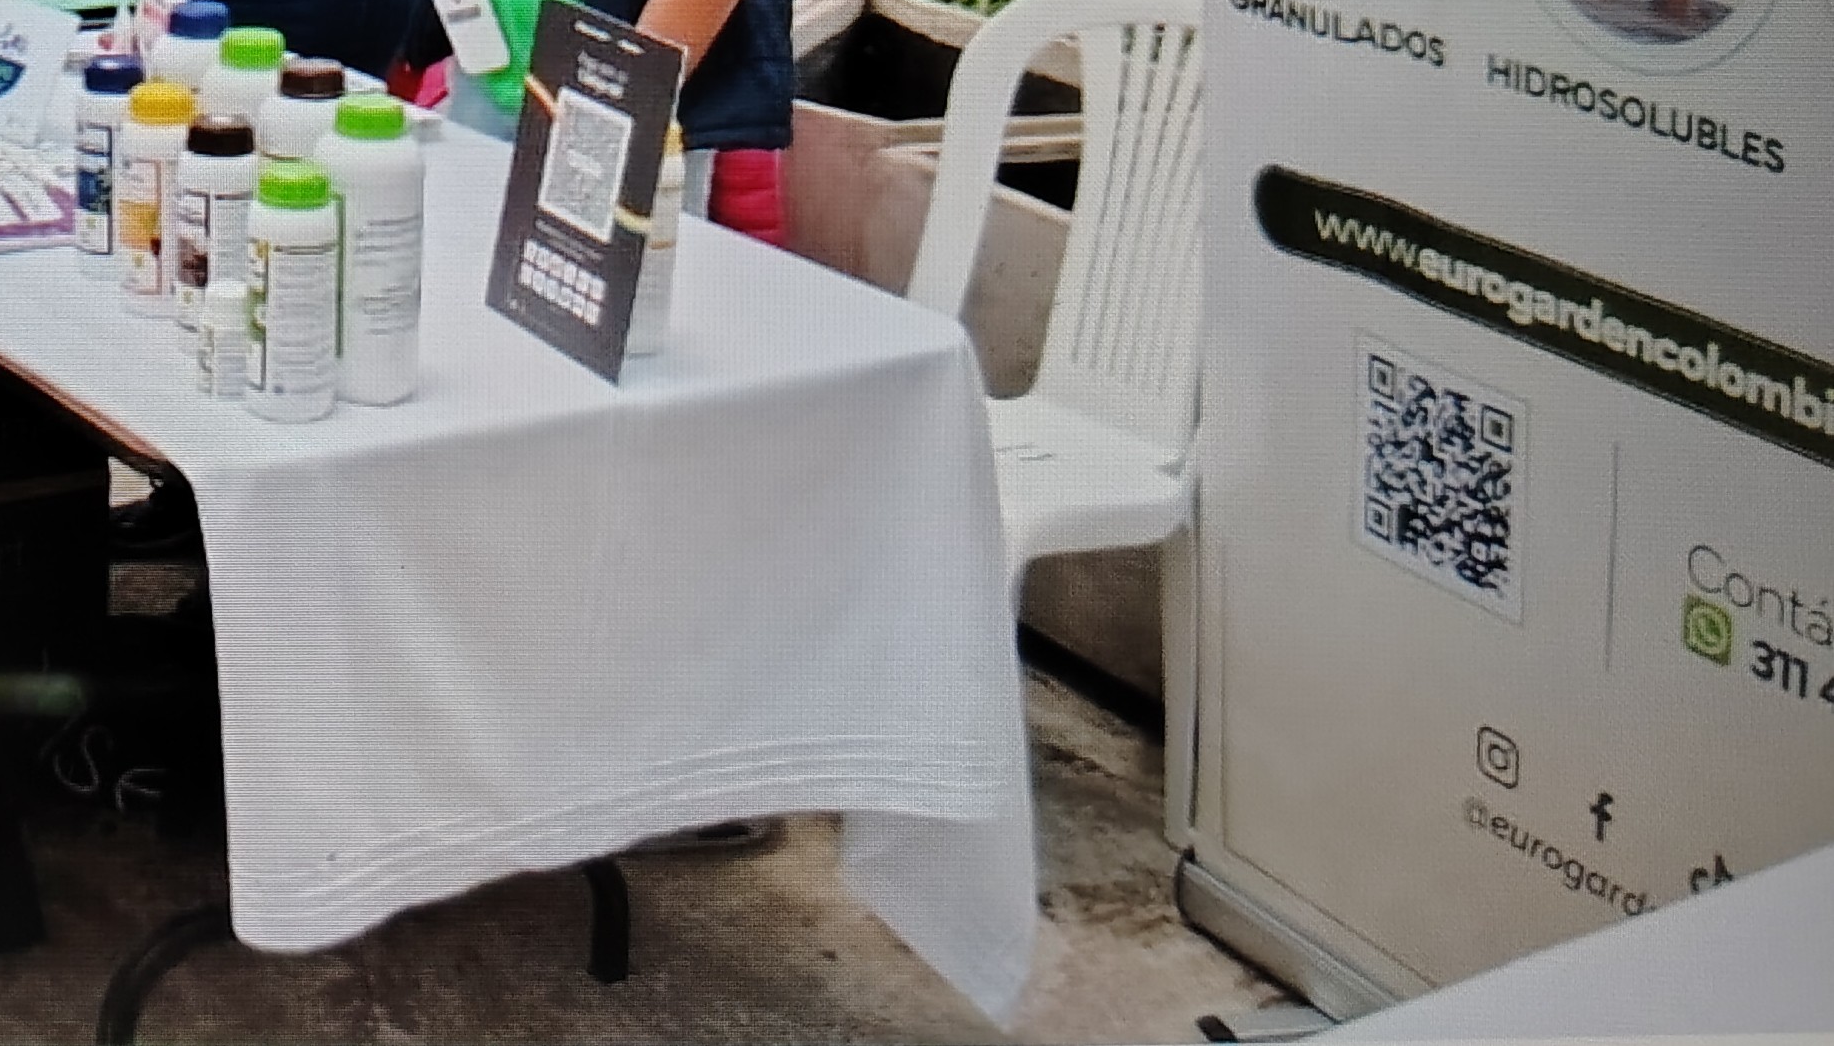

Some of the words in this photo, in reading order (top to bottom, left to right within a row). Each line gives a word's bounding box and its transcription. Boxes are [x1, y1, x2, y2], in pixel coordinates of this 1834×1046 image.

[1486, 54, 1785, 174] HIDROSOLUBLES
[1751, 639, 1809, 700] 311
[1465, 796, 1658, 916] @eurogard
